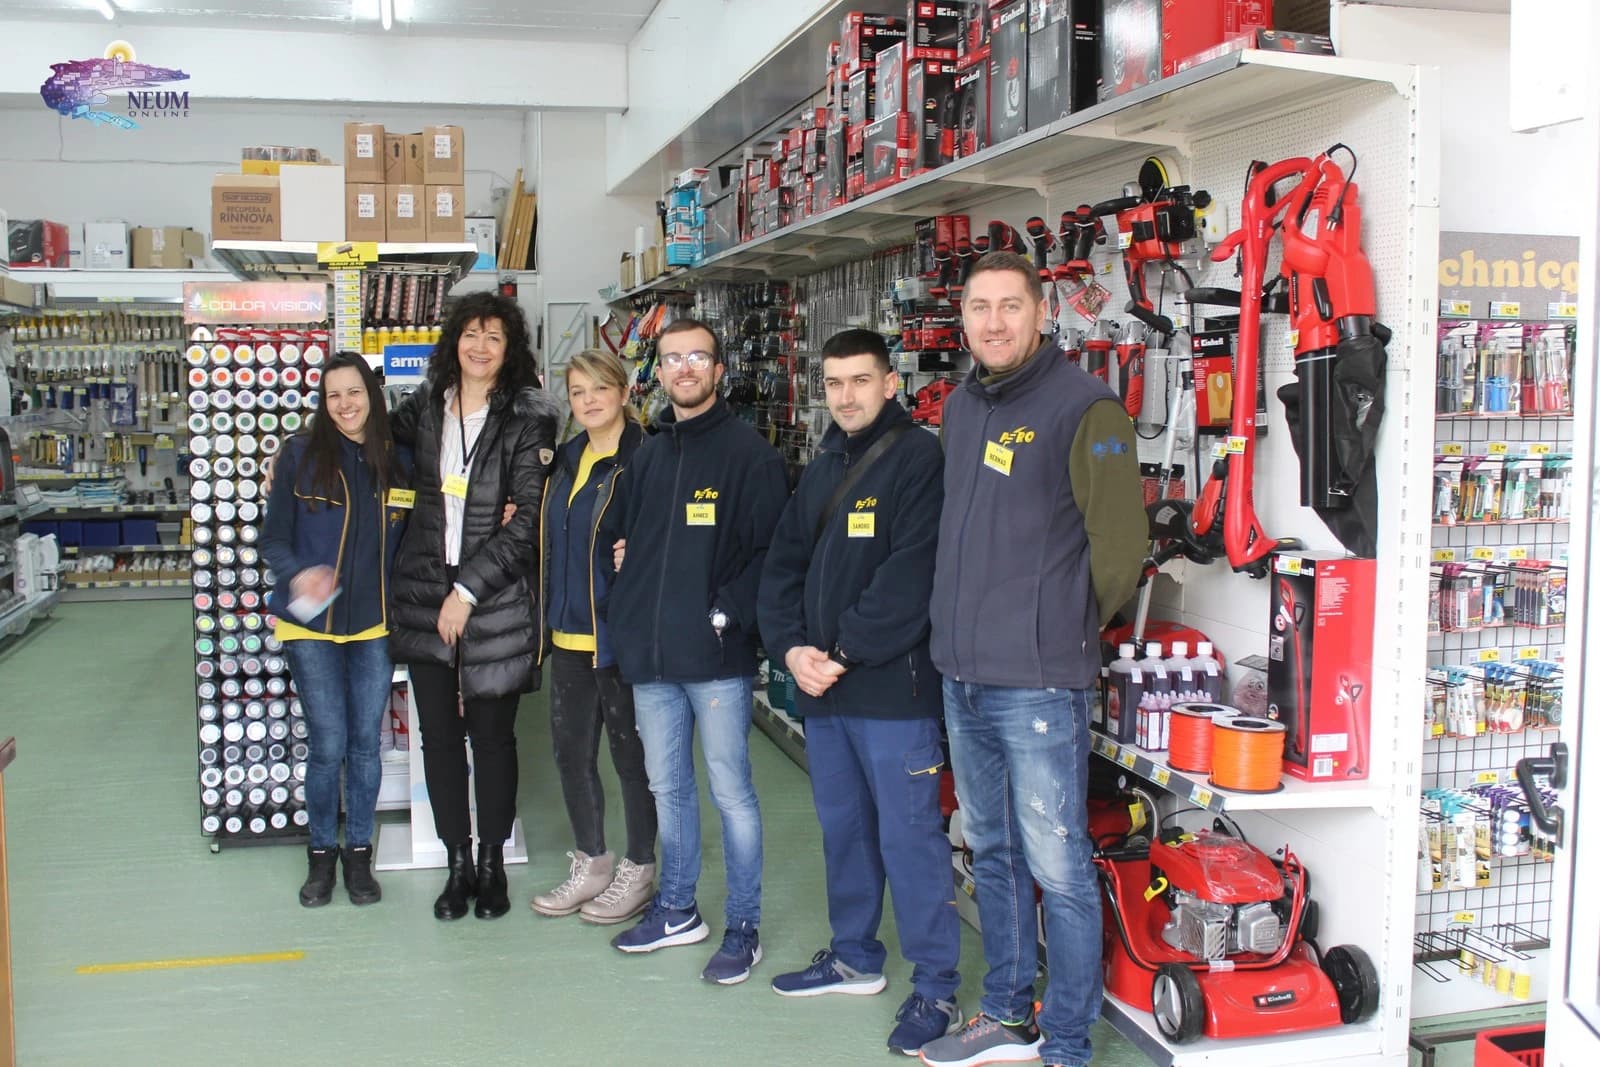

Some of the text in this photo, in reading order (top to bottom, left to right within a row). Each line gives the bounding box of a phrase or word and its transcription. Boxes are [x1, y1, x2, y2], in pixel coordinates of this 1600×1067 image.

[1000, 2, 1025, 25] Einhell
[960, 69, 980, 86] Einhell
[219, 212, 273, 223] RINNOVA
[208, 300, 265, 311] COLOR
[1200, 337, 1224, 347] Einhell
[390, 356, 428, 368] arm
